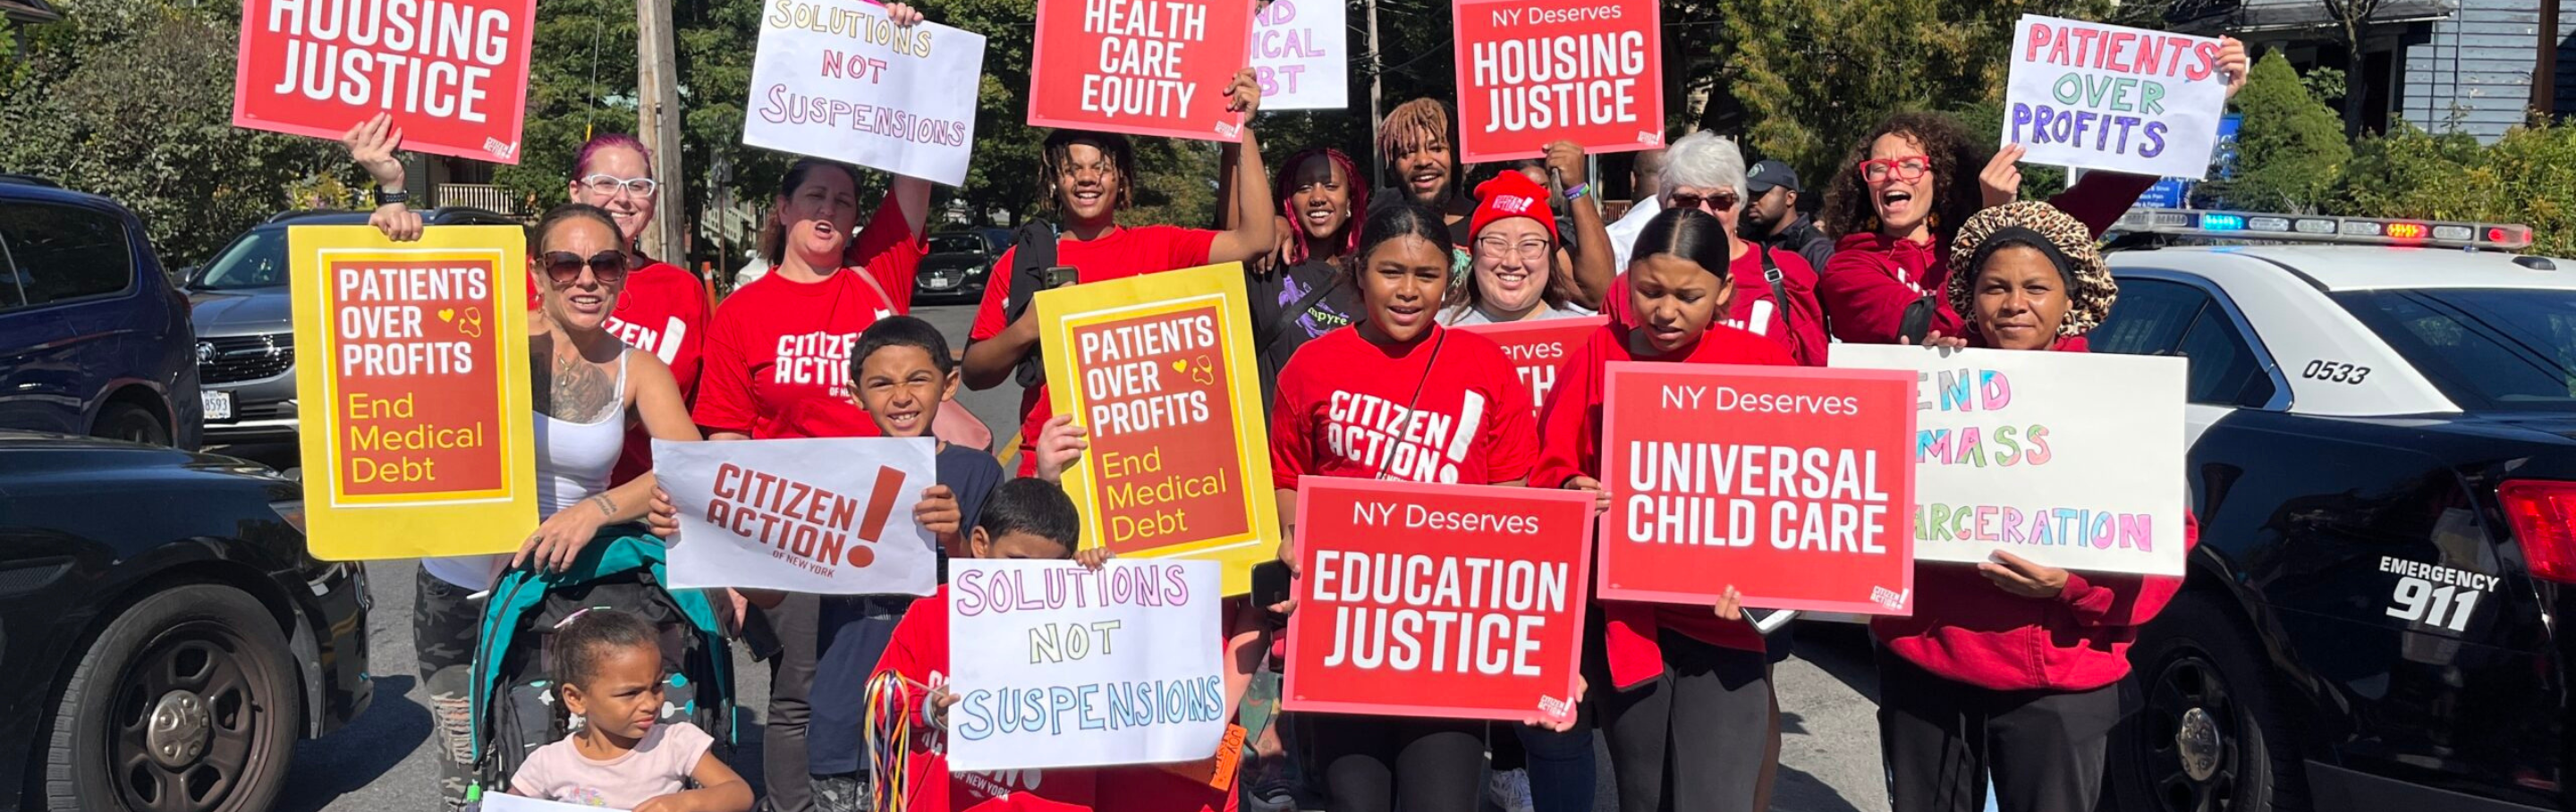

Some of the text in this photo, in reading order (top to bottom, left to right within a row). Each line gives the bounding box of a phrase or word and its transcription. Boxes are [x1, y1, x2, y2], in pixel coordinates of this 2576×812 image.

[268, 0, 510, 65] HOUSING
[769, 0, 932, 58] SOLUTIONS
[1084, 0, 1207, 41] HEALTH
[1492, 4, 1622, 27] NY Deserves
[821, 49, 886, 84] NOT
[1099, 37, 1184, 79] CARE
[1473, 30, 1644, 87] HOUSING
[2026, 23, 2220, 80] PATIENTS
[275, 38, 491, 123] JUSTICE
[1081, 73, 1197, 119] EQUITY
[2053, 72, 2165, 114] OVER
[760, 83, 965, 147] SUSPENSIONS
[1485, 78, 1637, 132] JUSTICE
[2012, 103, 2167, 158] PROFITS
[340, 267, 487, 301] PATIENTS
[341, 305, 423, 339] OVER
[1080, 315, 1215, 365] PATIENTS
[343, 341, 472, 376] PROFITS
[776, 330, 861, 359] CITIZE
[1087, 360, 1161, 401] OVER
[2302, 359, 2371, 385] 0533
[349, 392, 413, 419] End
[1092, 390, 1209, 437] PROFITS
[1328, 390, 1452, 450] CITIZEN
[1662, 385, 1859, 416] NY Deserves
[351, 421, 483, 451] Medical
[1916, 424, 2052, 468] MASS
[352, 456, 436, 483] Debt
[1102, 445, 1162, 478] End
[1629, 440, 1889, 502] UNIVERSAL
[713, 462, 859, 532] CITIZEN
[1106, 468, 1226, 511] Medical
[1112, 508, 1188, 543] Debt
[1352, 501, 1539, 535] NY Deserves
[1627, 494, 1887, 554] CHILD CARE
[773, 551, 835, 578] OF NEW YORK
[1312, 549, 1569, 613] EDUCATION
[2379, 556, 2500, 592] EMERGENCY
[956, 564, 1189, 616] SOLUTIONS
[2385, 577, 2479, 631] 911
[1029, 619, 1121, 664] NOT
[1324, 605, 1546, 677] JUSTICE
[959, 675, 1224, 741] SUSPENSIONS
[966, 774, 986, 790] NEW
[987, 781, 1011, 802] YORK
